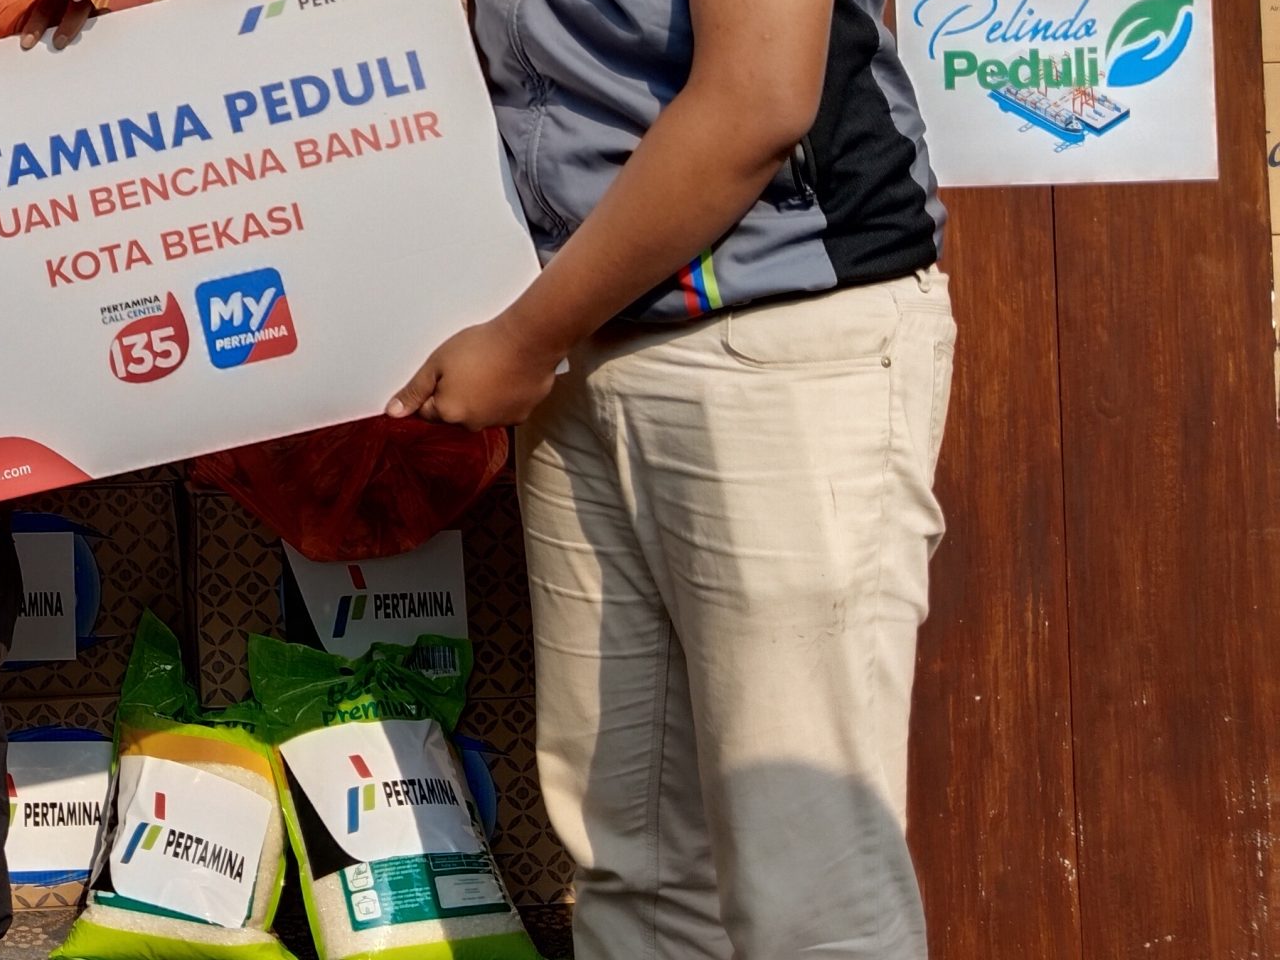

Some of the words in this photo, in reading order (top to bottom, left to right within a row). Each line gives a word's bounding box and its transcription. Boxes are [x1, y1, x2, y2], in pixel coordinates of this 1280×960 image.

[942, 46, 1100, 91] Peduli
[223, 50, 428, 134] PEDULI
[89, 148, 287, 218] BENCANA
[294, 110, 443, 170] BANJIR
[45, 238, 154, 288] KOTA
[160, 202, 304, 262] BEKASI
[100, 294, 162, 316] PERTAMINA
[102, 312, 126, 325] CALL
[127, 304, 162, 320] CENTER
[110, 326, 182, 379] 135
[215, 324, 289, 352] PERTAMINA
[373, 590, 454, 620] PERTAMINA
[384, 778, 460, 809] PERTAMINA
[23, 800, 103, 828] PERTAMINA
[163, 828, 245, 884] PERTAMINA
